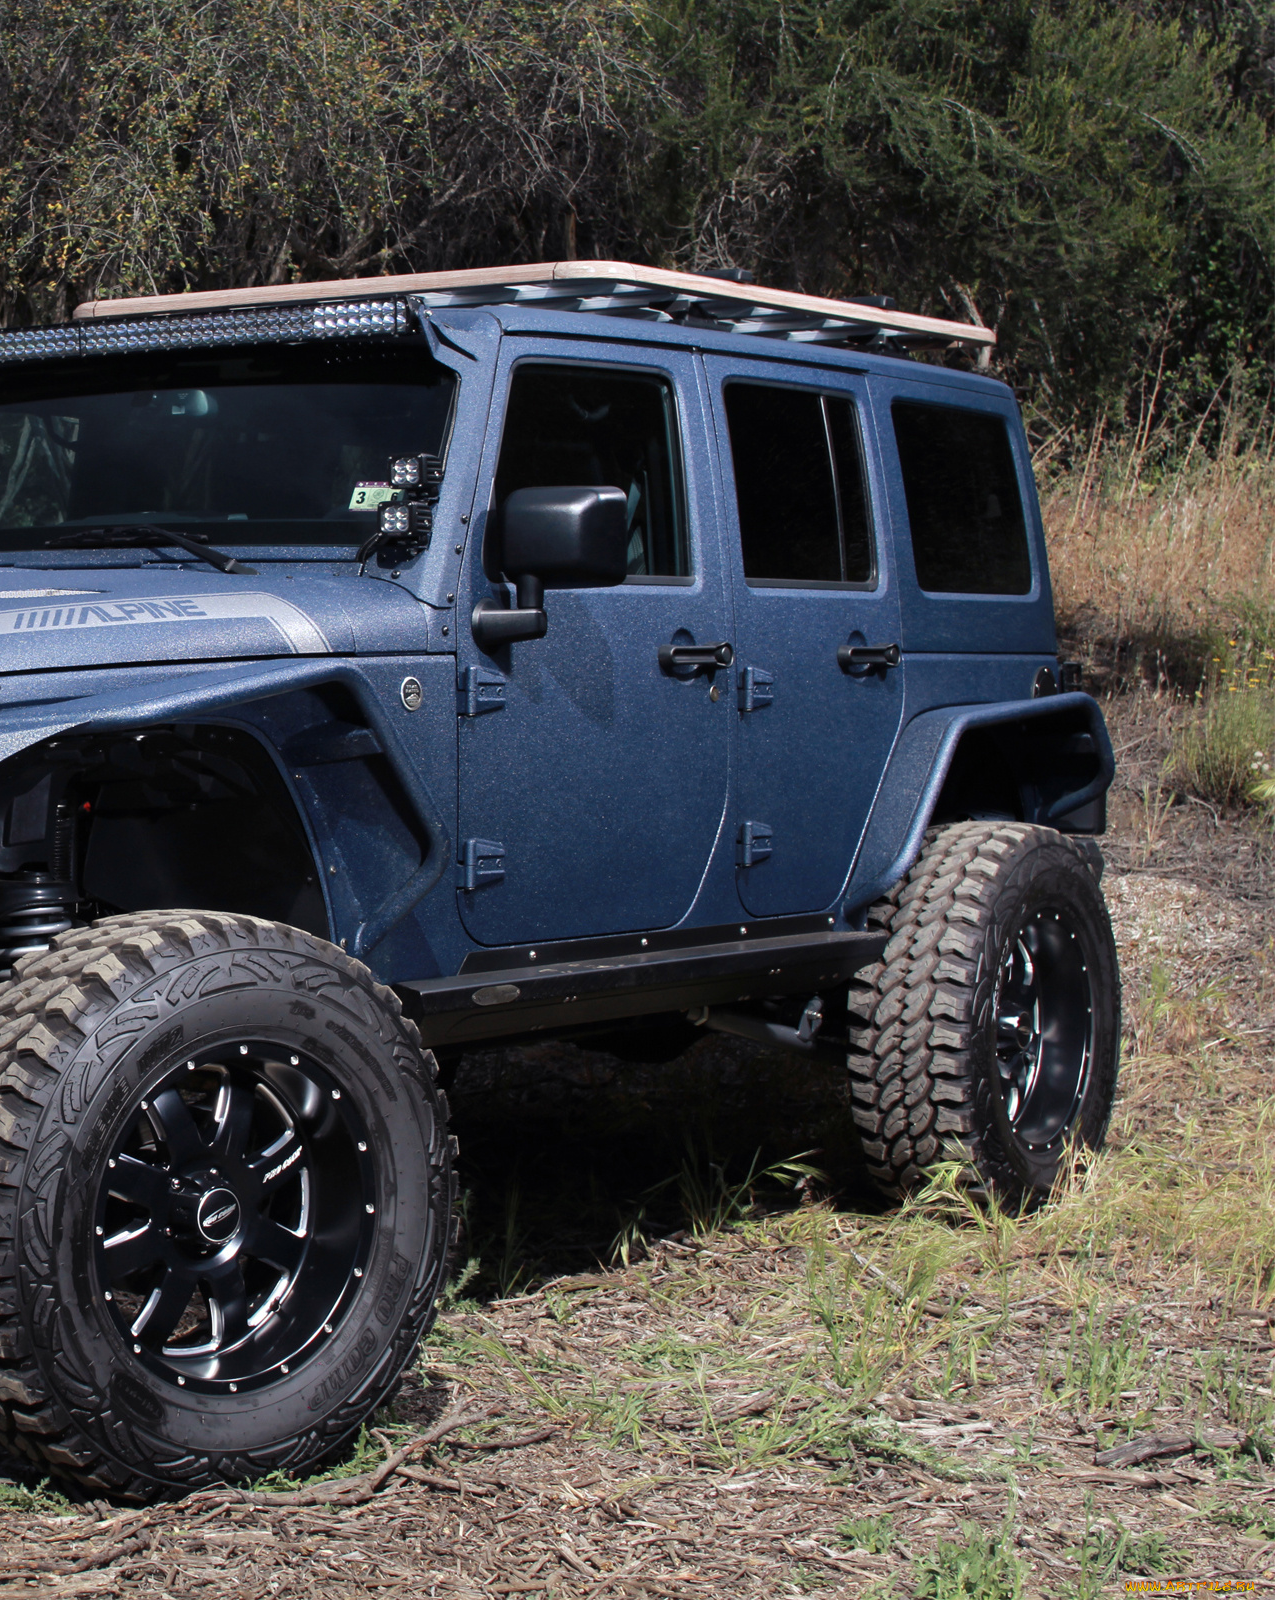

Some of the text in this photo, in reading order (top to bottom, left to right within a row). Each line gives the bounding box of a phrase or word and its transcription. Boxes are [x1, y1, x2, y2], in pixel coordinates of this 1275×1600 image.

[355, 491, 366, 505] 3
[77, 598, 207, 625] ALPINE
[375, 1252, 412, 1326] PRO
[307, 1327, 378, 1411] COMP
